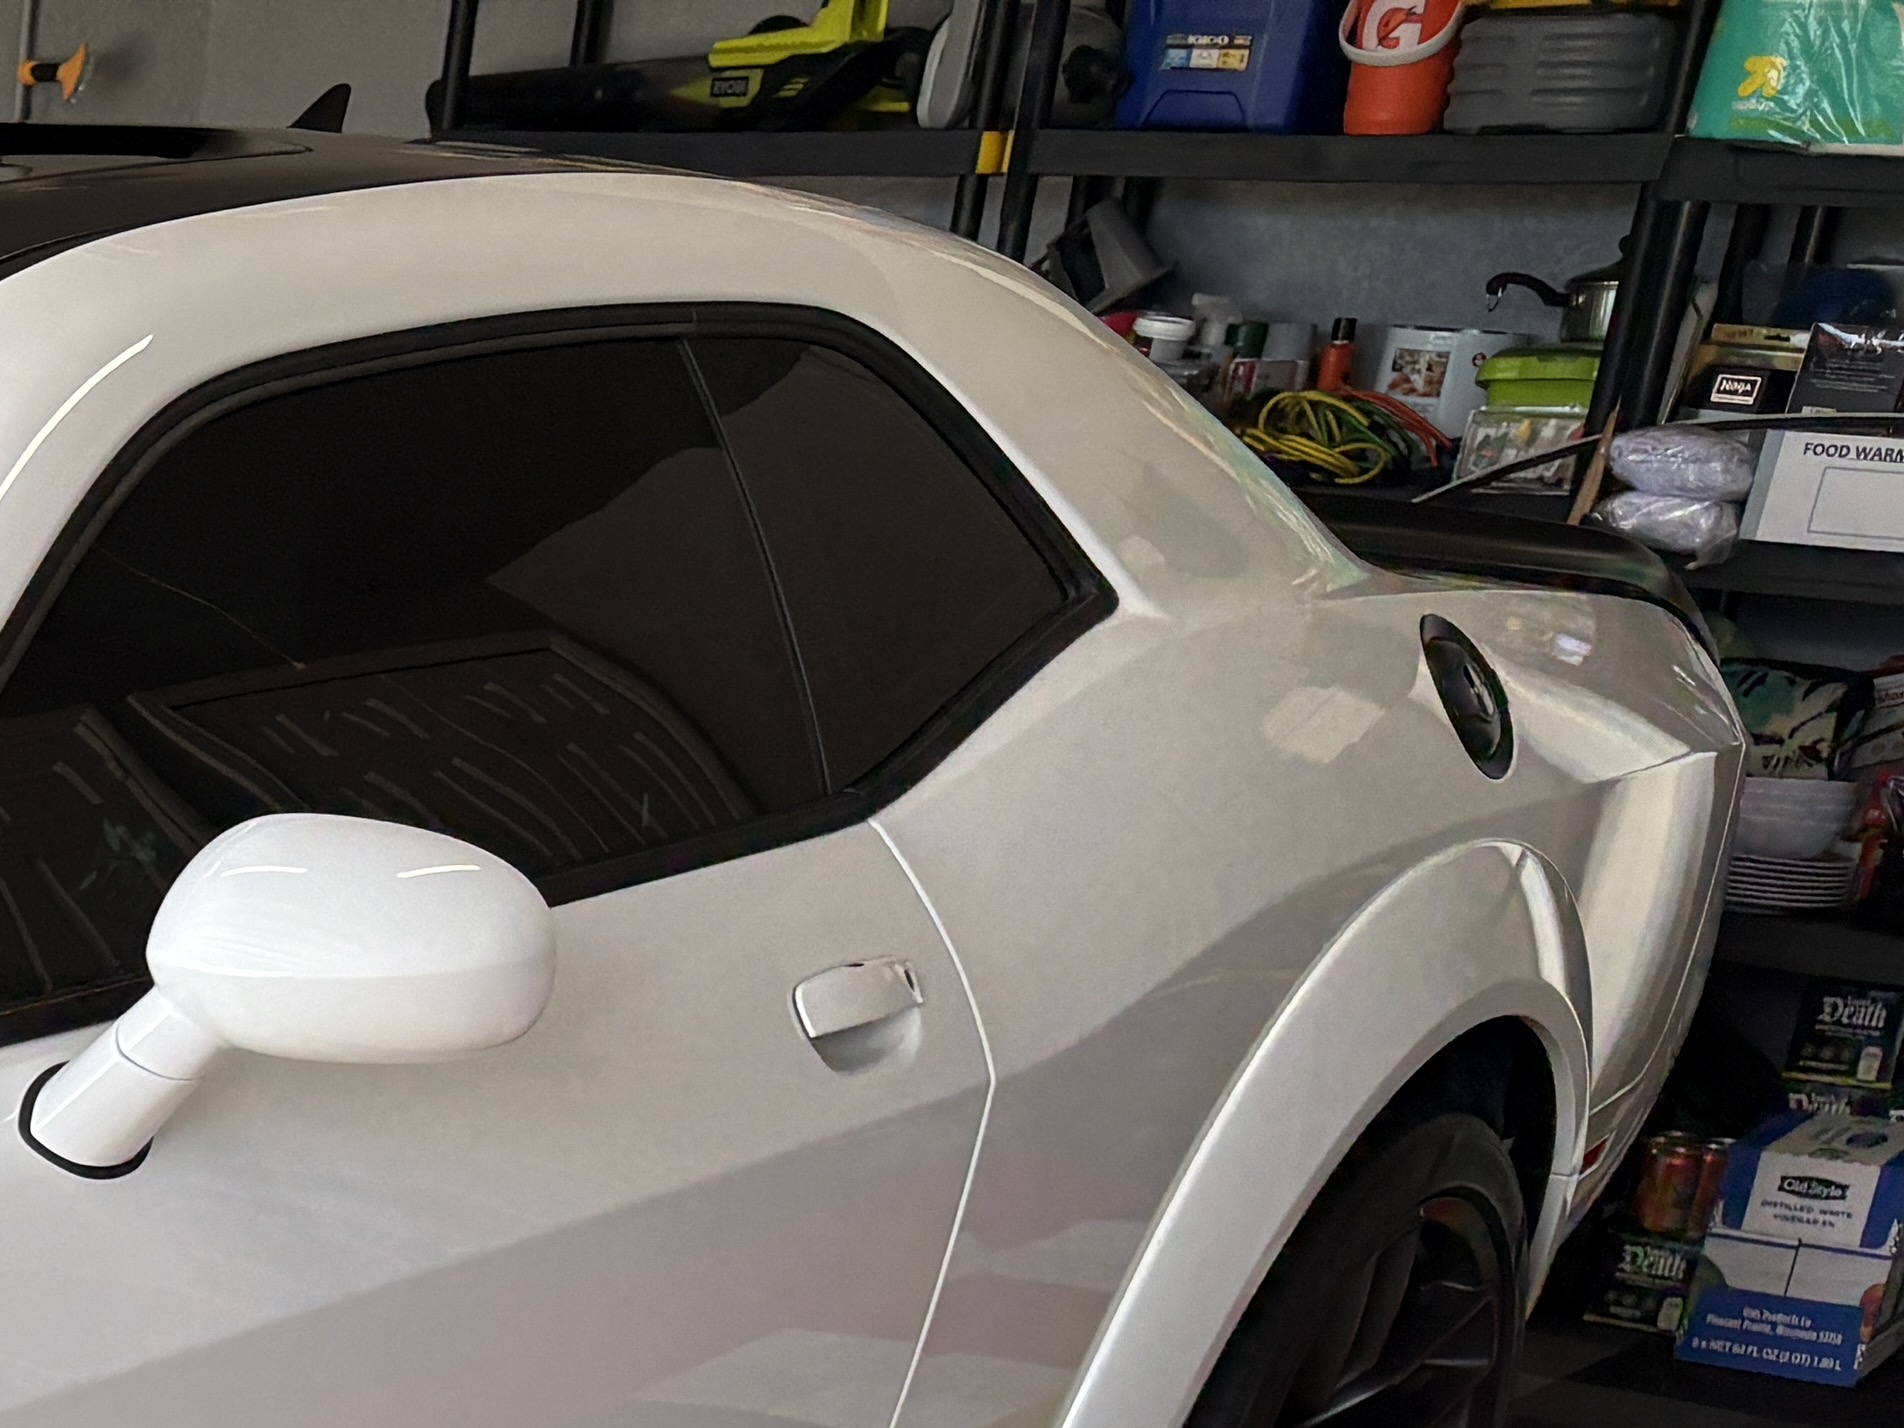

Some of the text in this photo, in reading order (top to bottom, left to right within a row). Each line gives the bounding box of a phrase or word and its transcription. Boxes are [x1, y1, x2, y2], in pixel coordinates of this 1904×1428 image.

[1803, 442, 1851, 459] FOOD
[1816, 996, 1887, 1028] Death
[1783, 1178, 1808, 1193] Old
